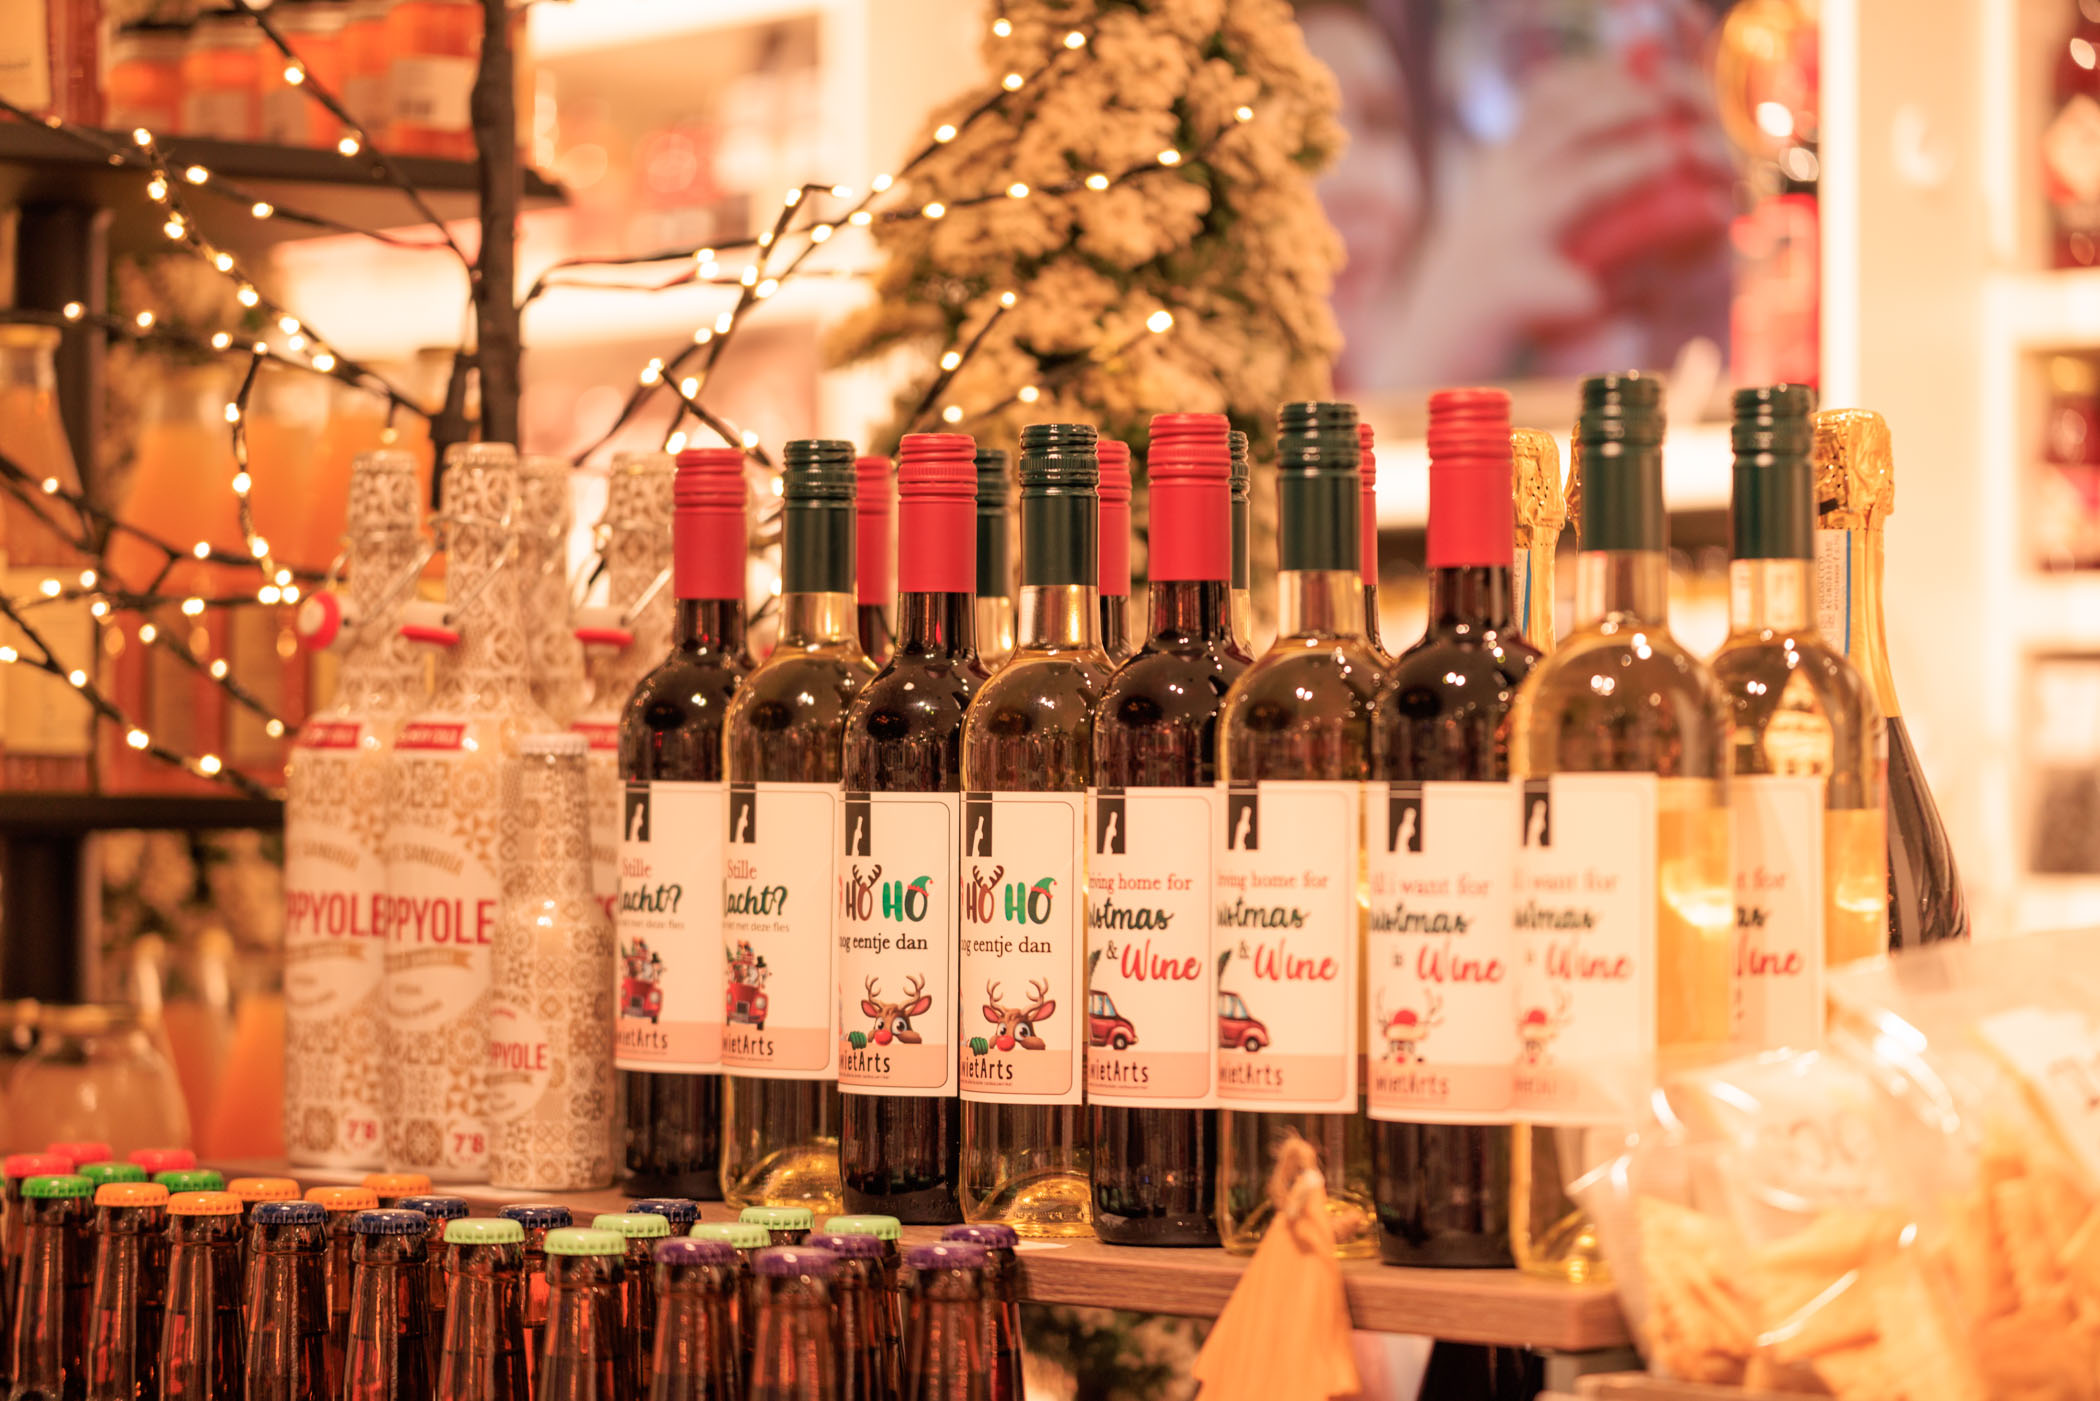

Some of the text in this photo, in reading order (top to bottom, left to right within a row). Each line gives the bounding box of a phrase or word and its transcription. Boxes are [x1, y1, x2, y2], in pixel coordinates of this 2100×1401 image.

[622, 859, 653, 879] Stille
[726, 859, 758, 880] Stille
[1251, 870, 1297, 890] home
[1302, 870, 1329, 890] for
[1583, 867, 1619, 891] for
[1118, 873, 1162, 892] home
[1167, 873, 1194, 892] for
[1401, 878, 1450, 895] want
[1456, 872, 1490, 896] for
[845, 876, 874, 922] HO
[882, 876, 929, 923] HO
[965, 877, 996, 924] HO
[1004, 878, 1051, 925] HO
[852, 933, 891, 954] eentje
[895, 933, 929, 951] dan
[973, 936, 1013, 957] eentje
[1018, 935, 1052, 954] dan
[1106, 939, 1203, 982] & Wine
[1238, 938, 1338, 982] & Wine
[1416, 939, 1506, 983] Wine
[1546, 937, 1634, 980] Wine
